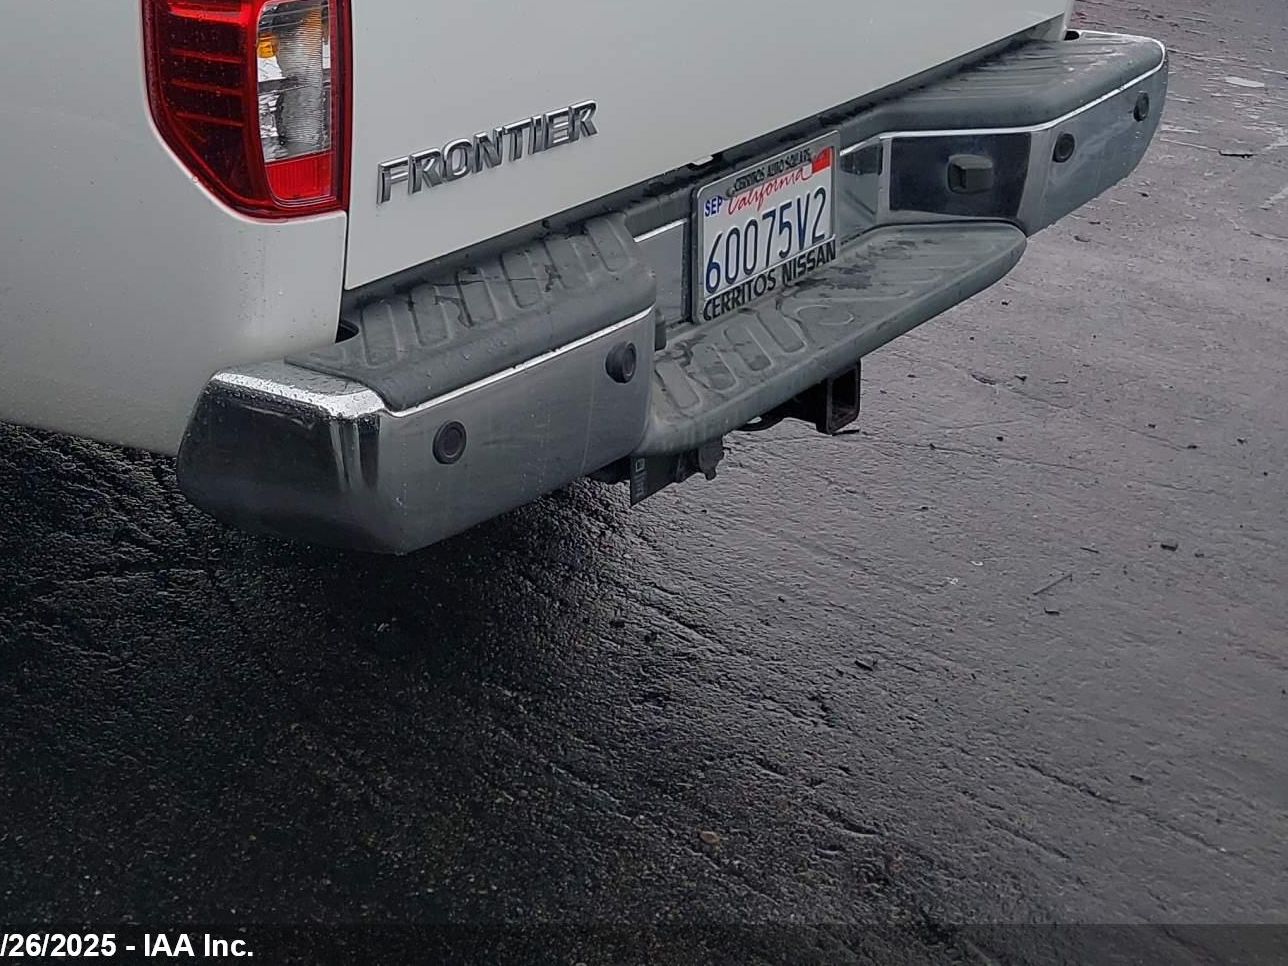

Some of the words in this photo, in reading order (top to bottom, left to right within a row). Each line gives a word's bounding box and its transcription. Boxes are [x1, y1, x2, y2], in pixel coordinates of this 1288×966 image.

[376, 99, 599, 205] FRONTIER
[728, 168, 810, 215] California
[704, 194, 723, 218] SEP
[705, 187, 827, 294] 60075V2
[703, 269, 777, 321] CERRITOS
[781, 239, 837, 284] NISSAN
